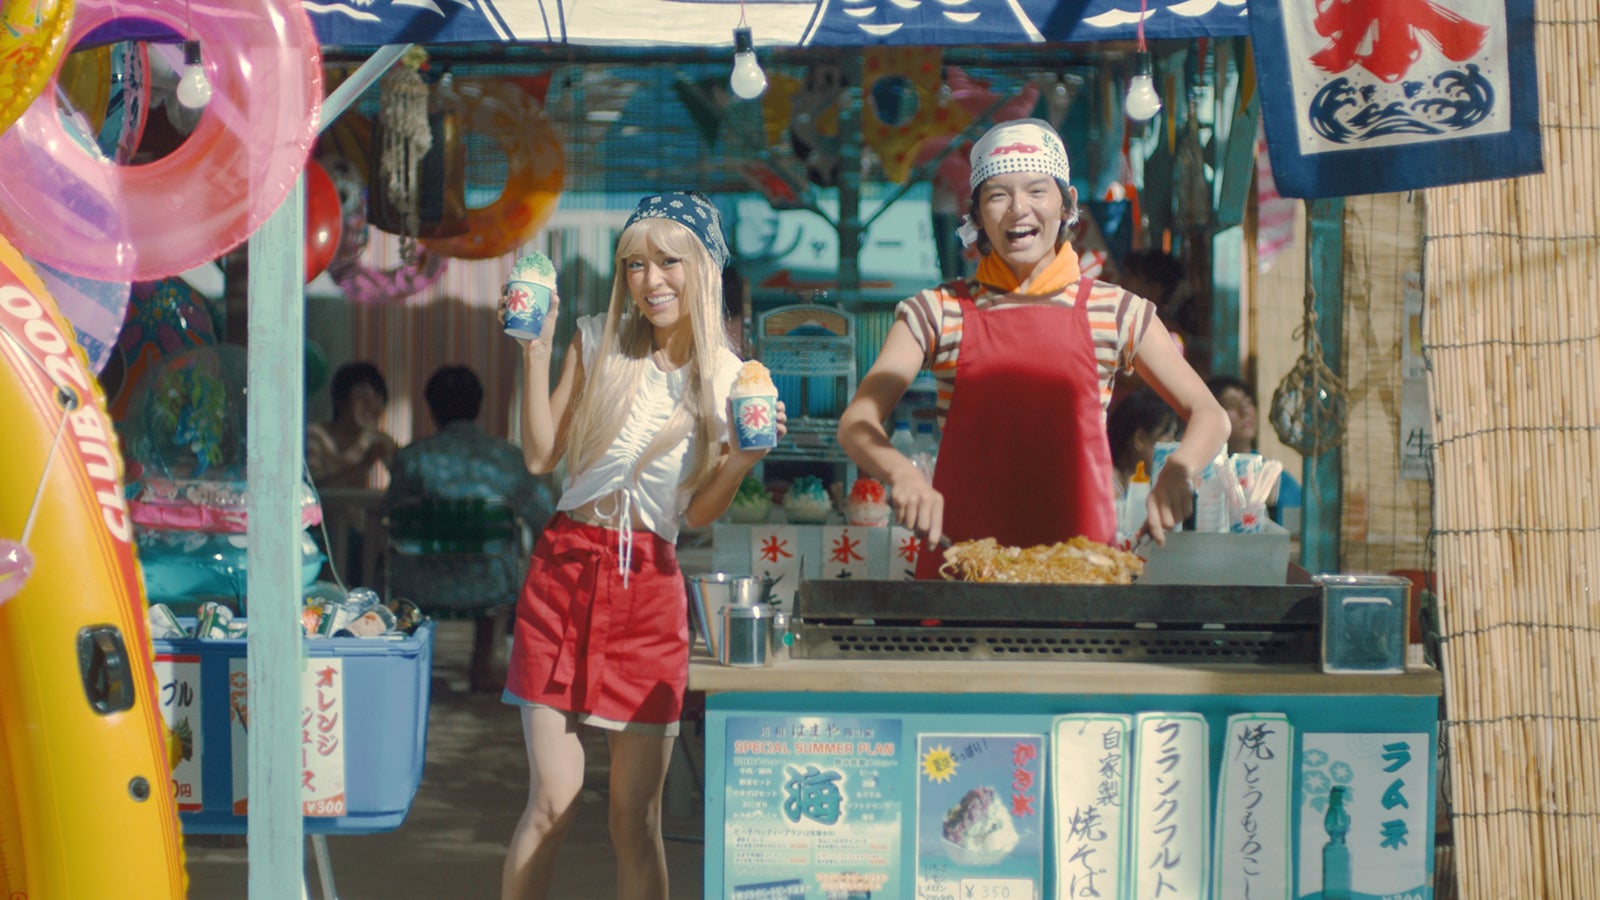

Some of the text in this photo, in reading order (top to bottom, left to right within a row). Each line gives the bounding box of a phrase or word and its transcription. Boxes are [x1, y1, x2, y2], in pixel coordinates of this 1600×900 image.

[507, 288, 529, 312] 氷
[742, 404, 769, 428] 氷
[69, 405, 132, 542] CLUB
[760, 535, 793, 563] 氷
[314, 665, 339, 757] オレンジ
[791, 723, 839, 739] はまや
[734, 741, 895, 757] SPECIAL SUMMER PLAN
[1010, 741, 1038, 818] かき氷
[1096, 726, 1124, 807] 自家製
[306, 800, 344, 815] ¥300
[783, 765, 843, 825] 海
[1149, 722, 1182, 899] フランクフルト
[1234, 722, 1276, 900] 焼とうもろこし
[1379, 741, 1412, 850] ラムネ
[1066, 804, 1108, 899] 焼そば
[982, 886, 1011, 899] 350
